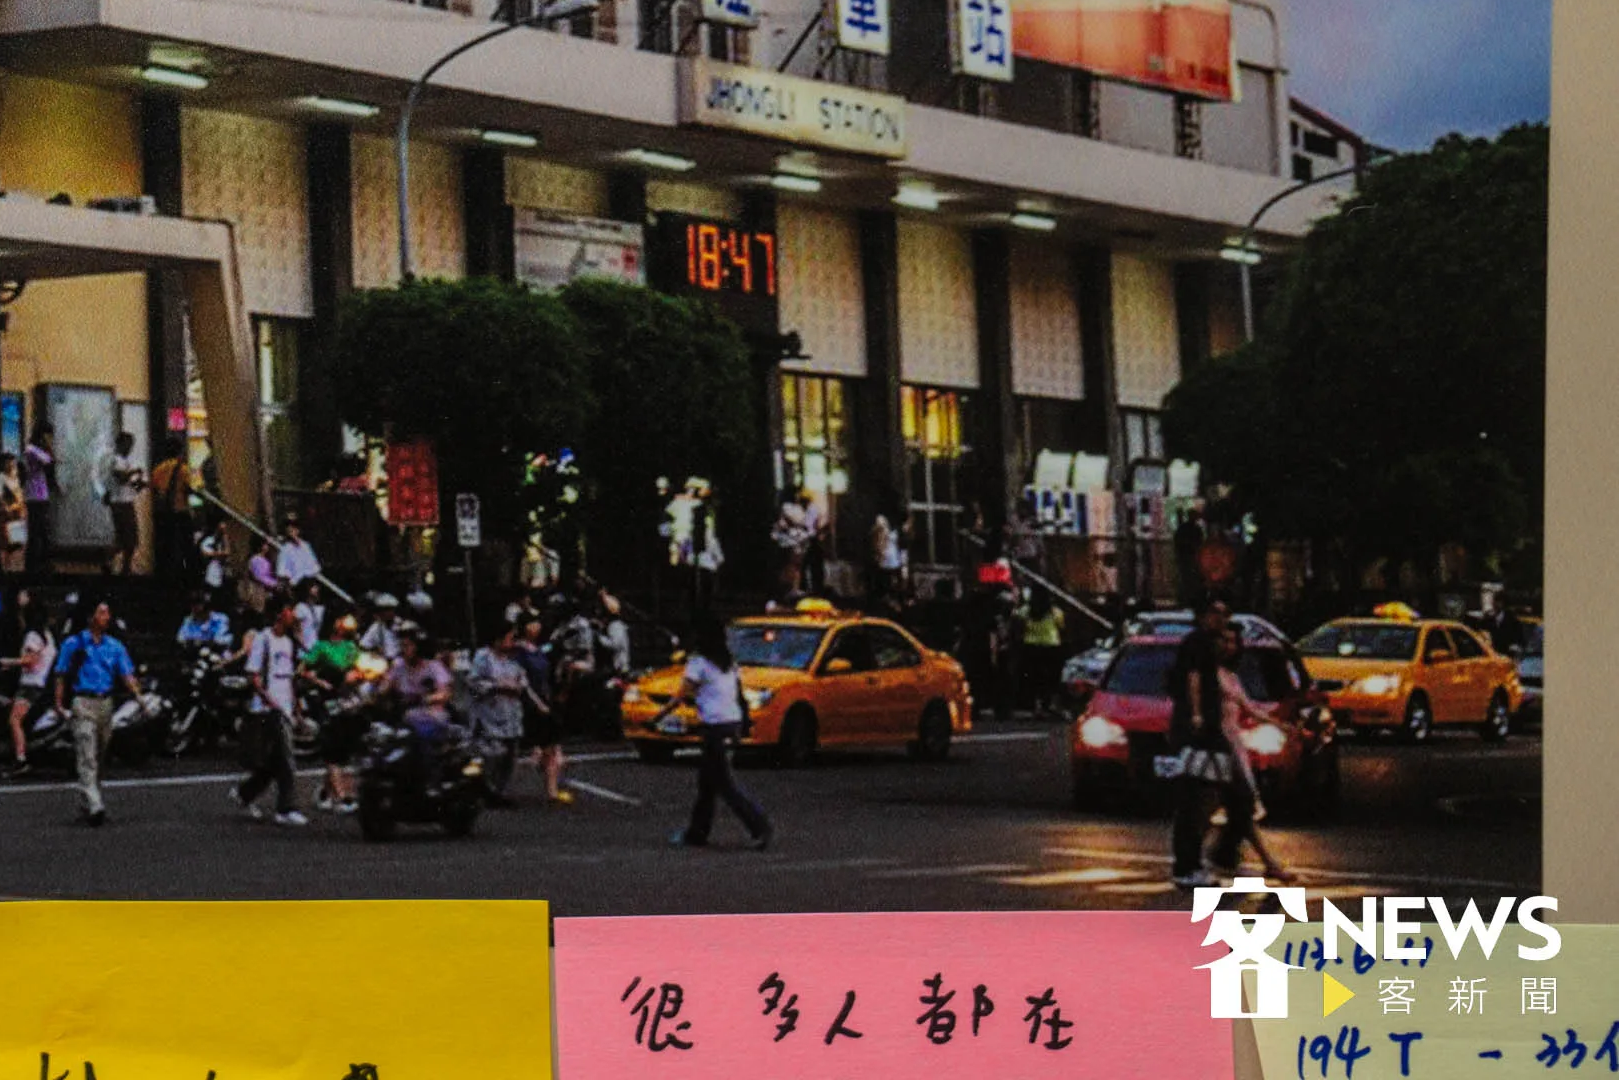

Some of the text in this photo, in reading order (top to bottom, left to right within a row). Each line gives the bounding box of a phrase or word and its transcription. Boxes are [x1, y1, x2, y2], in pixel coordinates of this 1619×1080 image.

[819, 96, 901, 143] STATION
[686, 222, 775, 296] 18:47
[621, 972, 1074, 1051] 很多人都在
